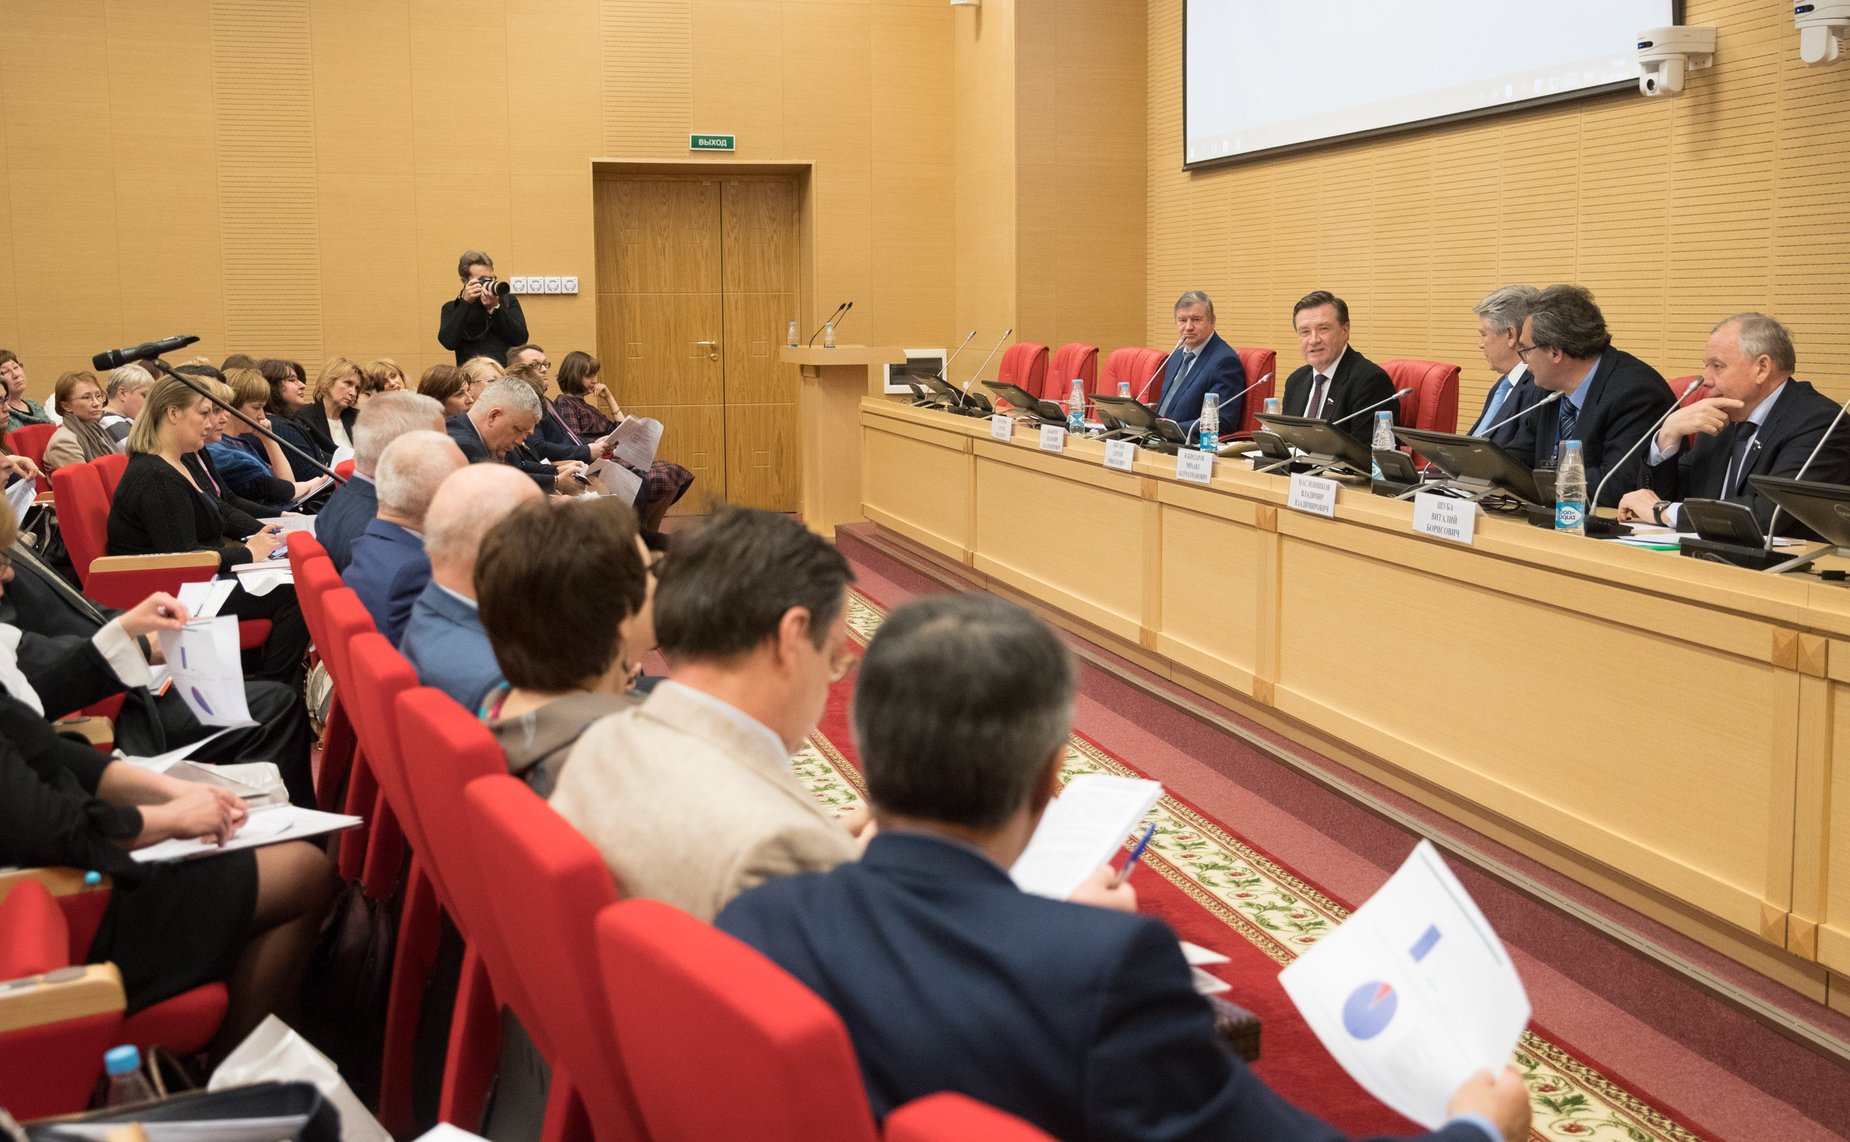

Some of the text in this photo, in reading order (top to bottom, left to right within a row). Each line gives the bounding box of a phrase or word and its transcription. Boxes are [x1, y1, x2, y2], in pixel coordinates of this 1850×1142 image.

[698, 138, 728, 147] ВЫХОД
[1431, 512, 1458, 525] ВИТАЛИЙ
[1426, 524, 1460, 537] БОРИСОВИЧ
